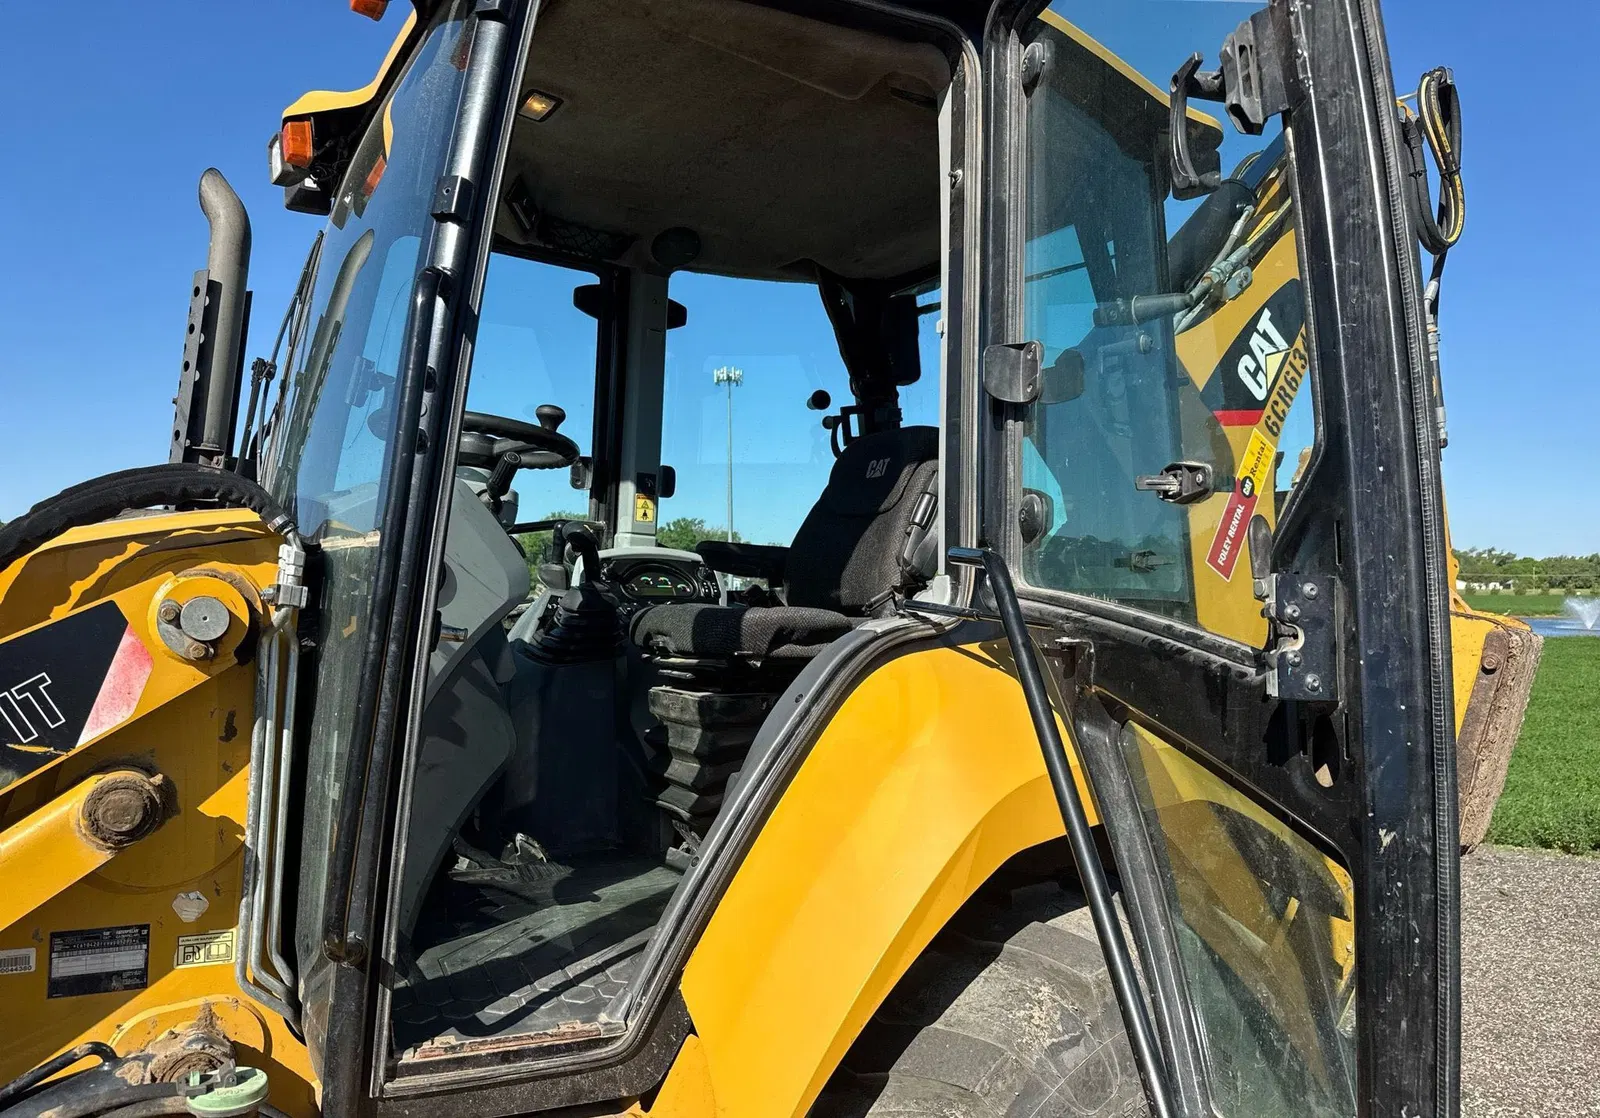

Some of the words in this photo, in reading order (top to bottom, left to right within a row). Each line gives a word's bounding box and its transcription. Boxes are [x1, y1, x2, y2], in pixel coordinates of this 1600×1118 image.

[1238, 307, 1289, 401] CAT
[866, 457, 891, 478] CAT
[1243, 479, 1253, 496] CAT
[1250, 440, 1266, 477] Rental
[1217, 536, 1232, 566] FOLEY
[1227, 504, 1245, 538] RENTAL
